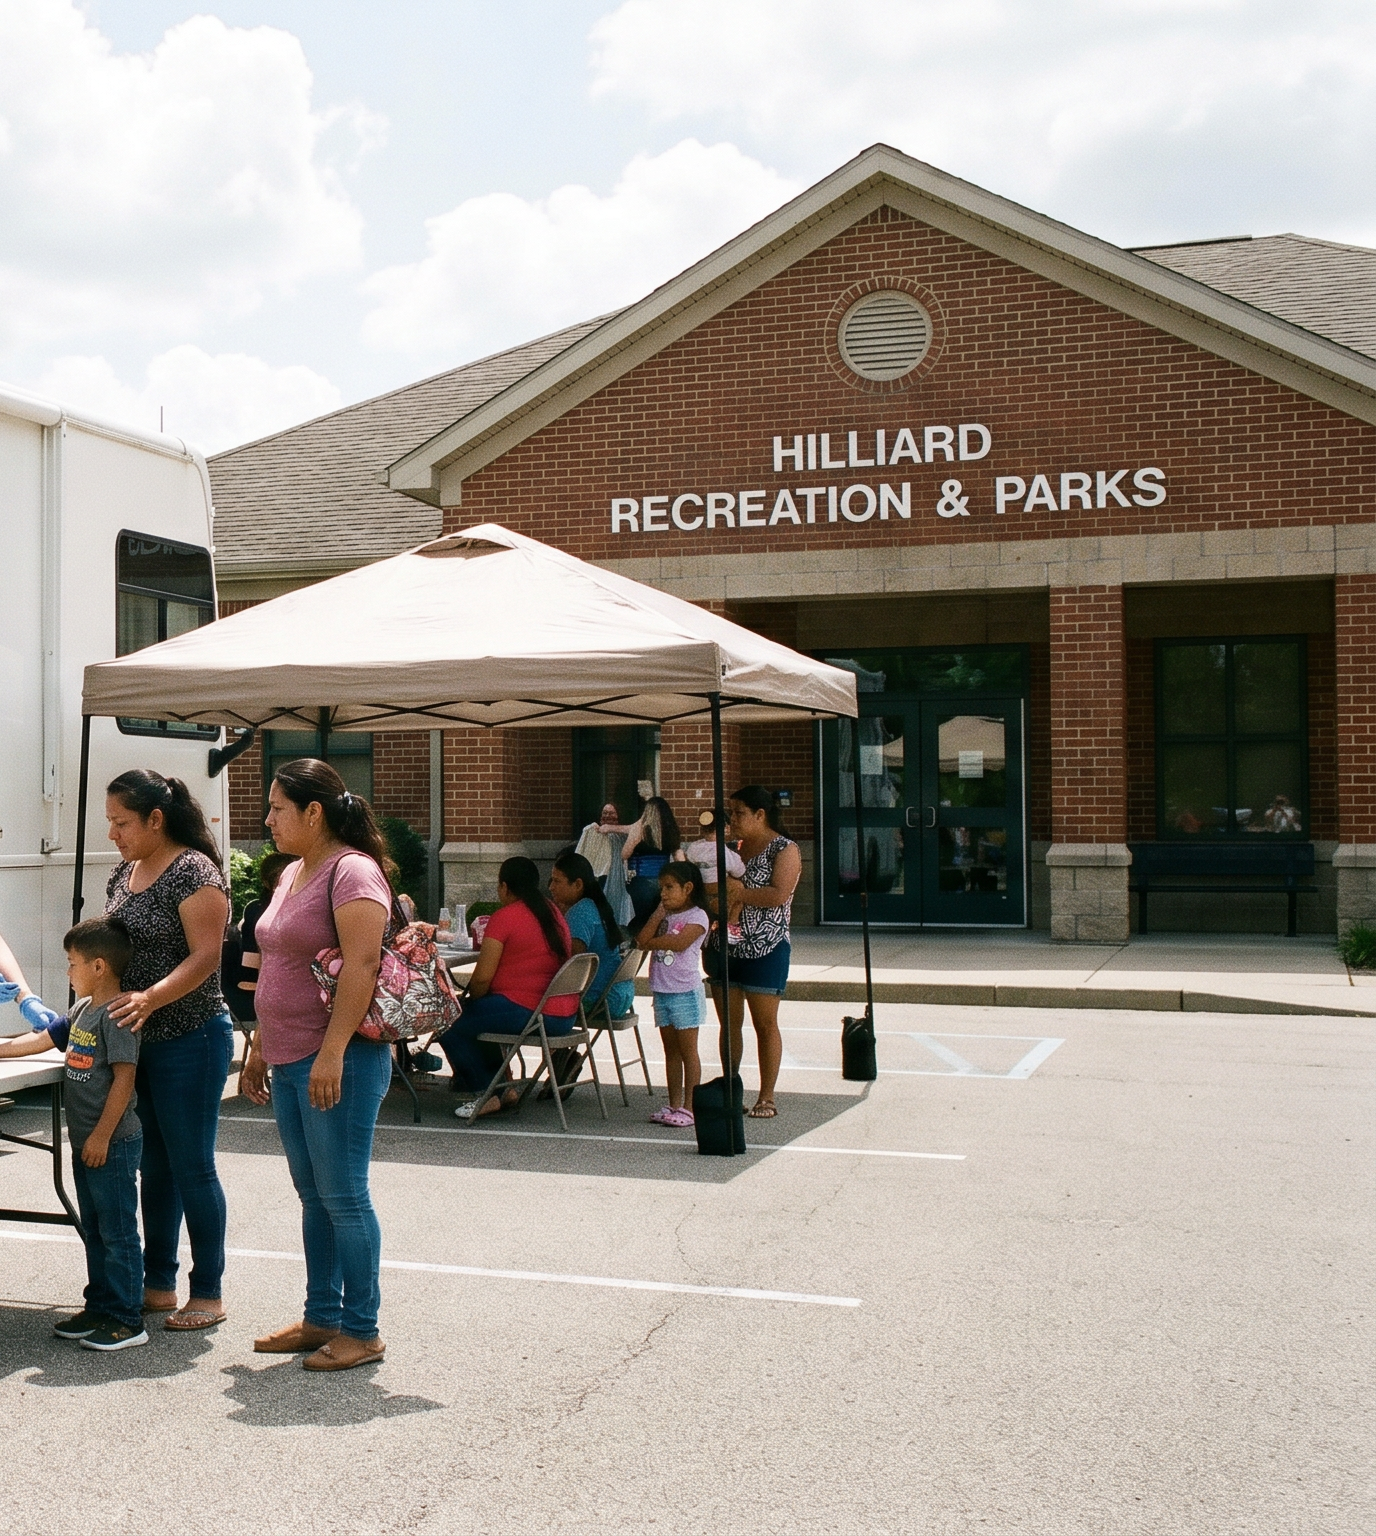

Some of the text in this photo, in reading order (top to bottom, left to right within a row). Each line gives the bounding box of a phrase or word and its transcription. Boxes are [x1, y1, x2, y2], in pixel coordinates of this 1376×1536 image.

[773, 423, 992, 472] HILLIARD
[611, 467, 1167, 533] RECREATION & PARKS
